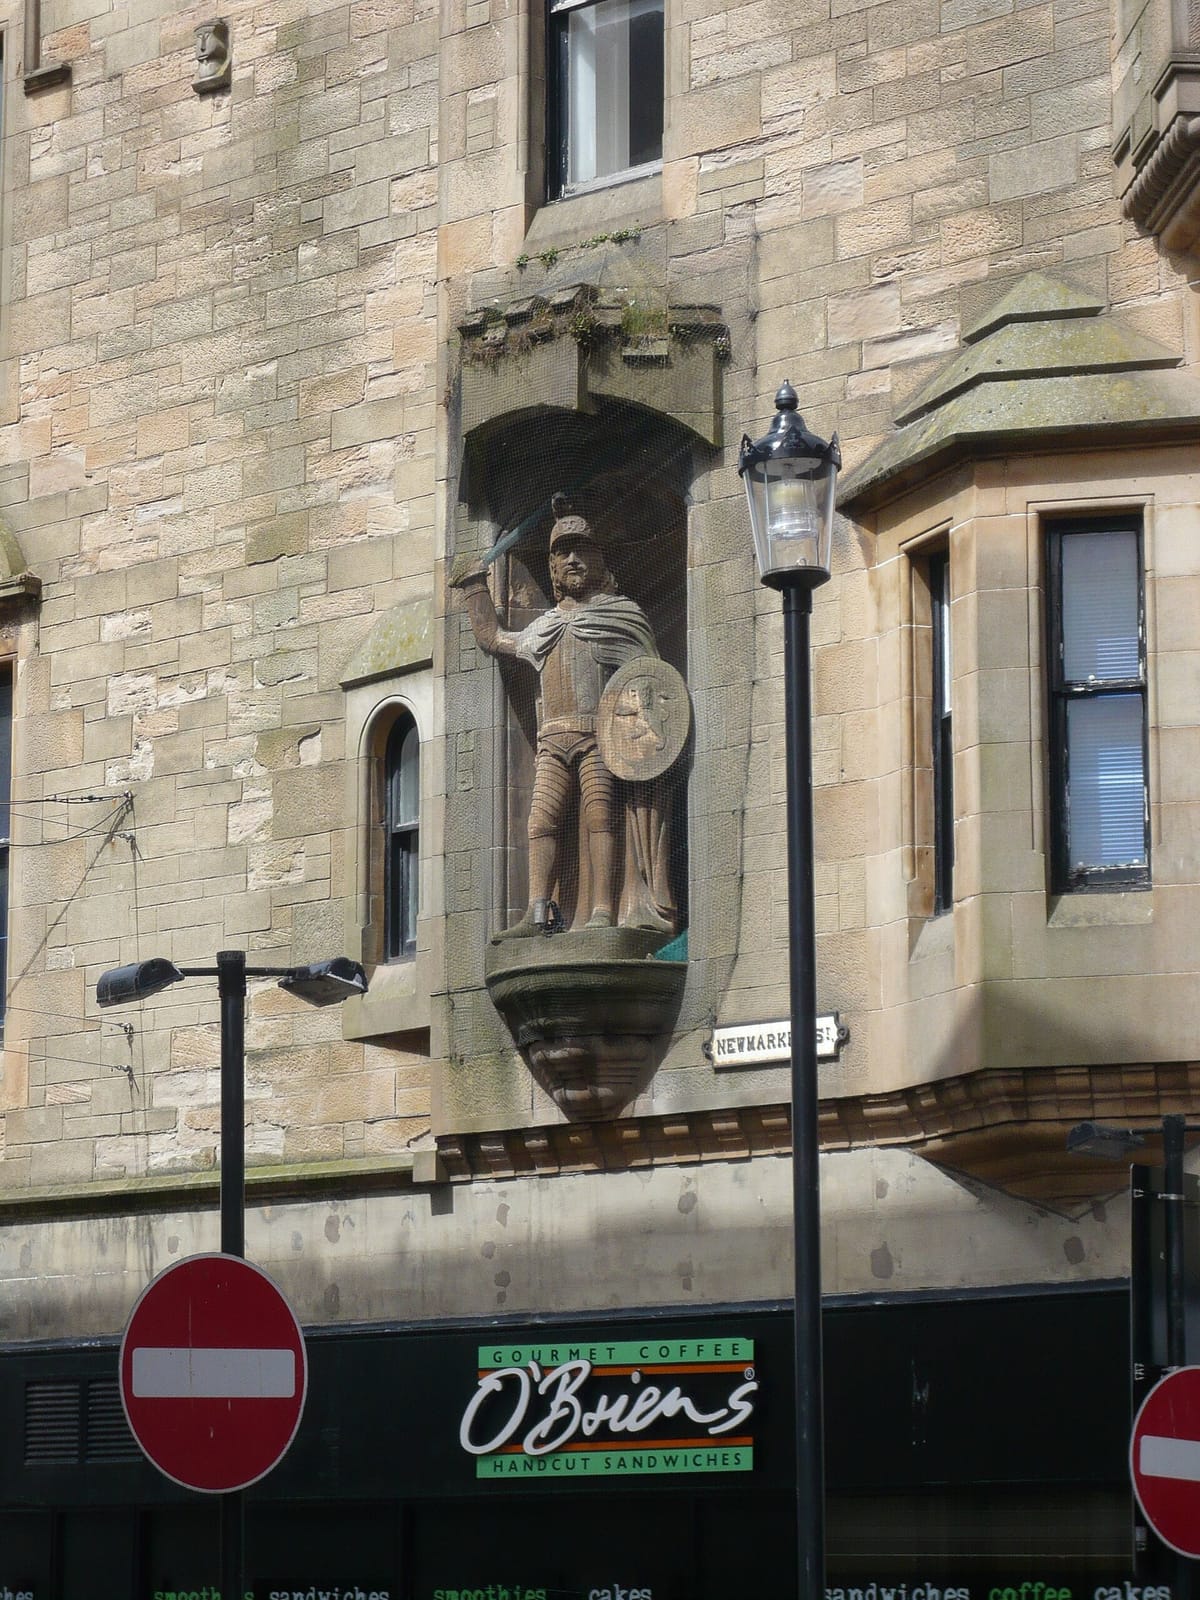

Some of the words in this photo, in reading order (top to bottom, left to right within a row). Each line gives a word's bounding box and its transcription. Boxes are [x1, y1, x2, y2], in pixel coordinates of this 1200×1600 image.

[716, 1031, 792, 1055] NEWMARK
[493, 1347, 617, 1363] GOURMET
[639, 1343, 740, 1359] COFFEE
[460, 1359, 759, 1456] O'Briens
[493, 1457, 592, 1473] HANDCUT
[604, 1453, 742, 1470] SANDWICHES
[153, 1586, 255, 1600] smooths
[269, 1586, 390, 1600] sandwiches
[433, 1585, 547, 1600] smoothies
[588, 1583, 653, 1600] cakes
[989, 1581, 1072, 1600] coffee
[1094, 1581, 1172, 1600] cakes
